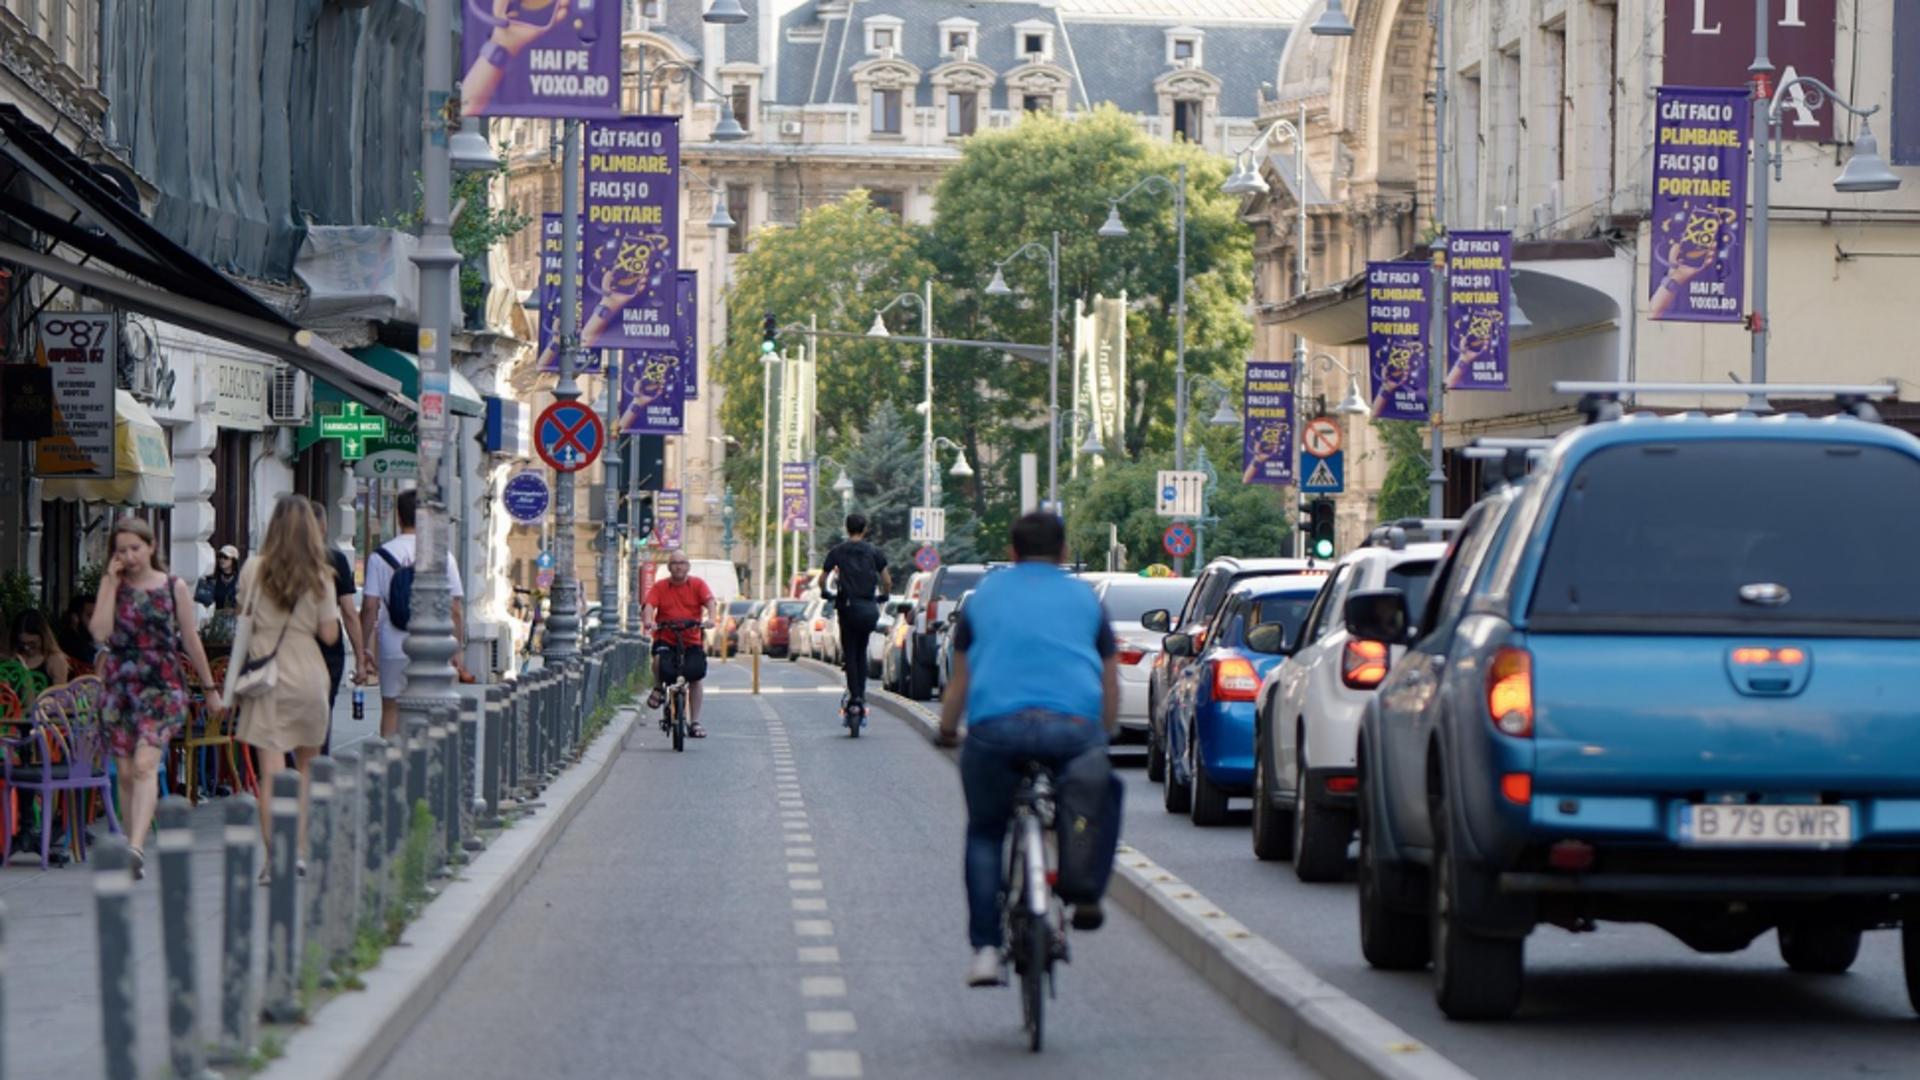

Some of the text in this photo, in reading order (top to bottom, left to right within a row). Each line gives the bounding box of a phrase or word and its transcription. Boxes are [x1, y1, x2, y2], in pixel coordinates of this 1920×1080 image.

[530, 49, 588, 71] HAI PE
[530, 75, 609, 96] YOXO.RO
[1768, 65, 1820, 126] A
[1661, 101, 1733, 121] CÂT FACI O
[591, 127, 662, 147] CÂT FACI O
[1661, 127, 1742, 148] PLIMBARE,
[590, 154, 672, 175] PLIMBARE,
[1660, 154, 1690, 171] FACI
[1708, 156, 1719, 171] O
[590, 181, 620, 198] FACI
[639, 182, 649, 198] O
[1659, 177, 1731, 197] PORTARE
[590, 205, 662, 223] PORTARE
[1452, 238, 1499, 253] CÂT FACI O
[1452, 256, 1506, 271] PLIMBARE,
[1371, 269, 1420, 284] CÂT FACI O
[1451, 275, 1472, 288] FACI
[1484, 275, 1491, 288] O
[1371, 287, 1426, 302] PLIMBARE,
[1690, 281, 1725, 295] HAI PE
[1451, 292, 1499, 304] PORTARE
[1689, 296, 1737, 310] YOXO.RO
[623, 308, 658, 321] HAI PE
[1371, 306, 1391, 317] FACI
[1403, 306, 1411, 318] O
[623, 323, 670, 336] YOXO.RO
[1372, 321, 1419, 335] PORTARE
[1473, 361, 1496, 371] HAI PE
[1473, 371, 1504, 381] YOXO.RO
[1395, 391, 1416, 401] HAI PE
[1395, 401, 1425, 411] YOXO.RO
[1699, 807, 1841, 836] B 79 GWR
